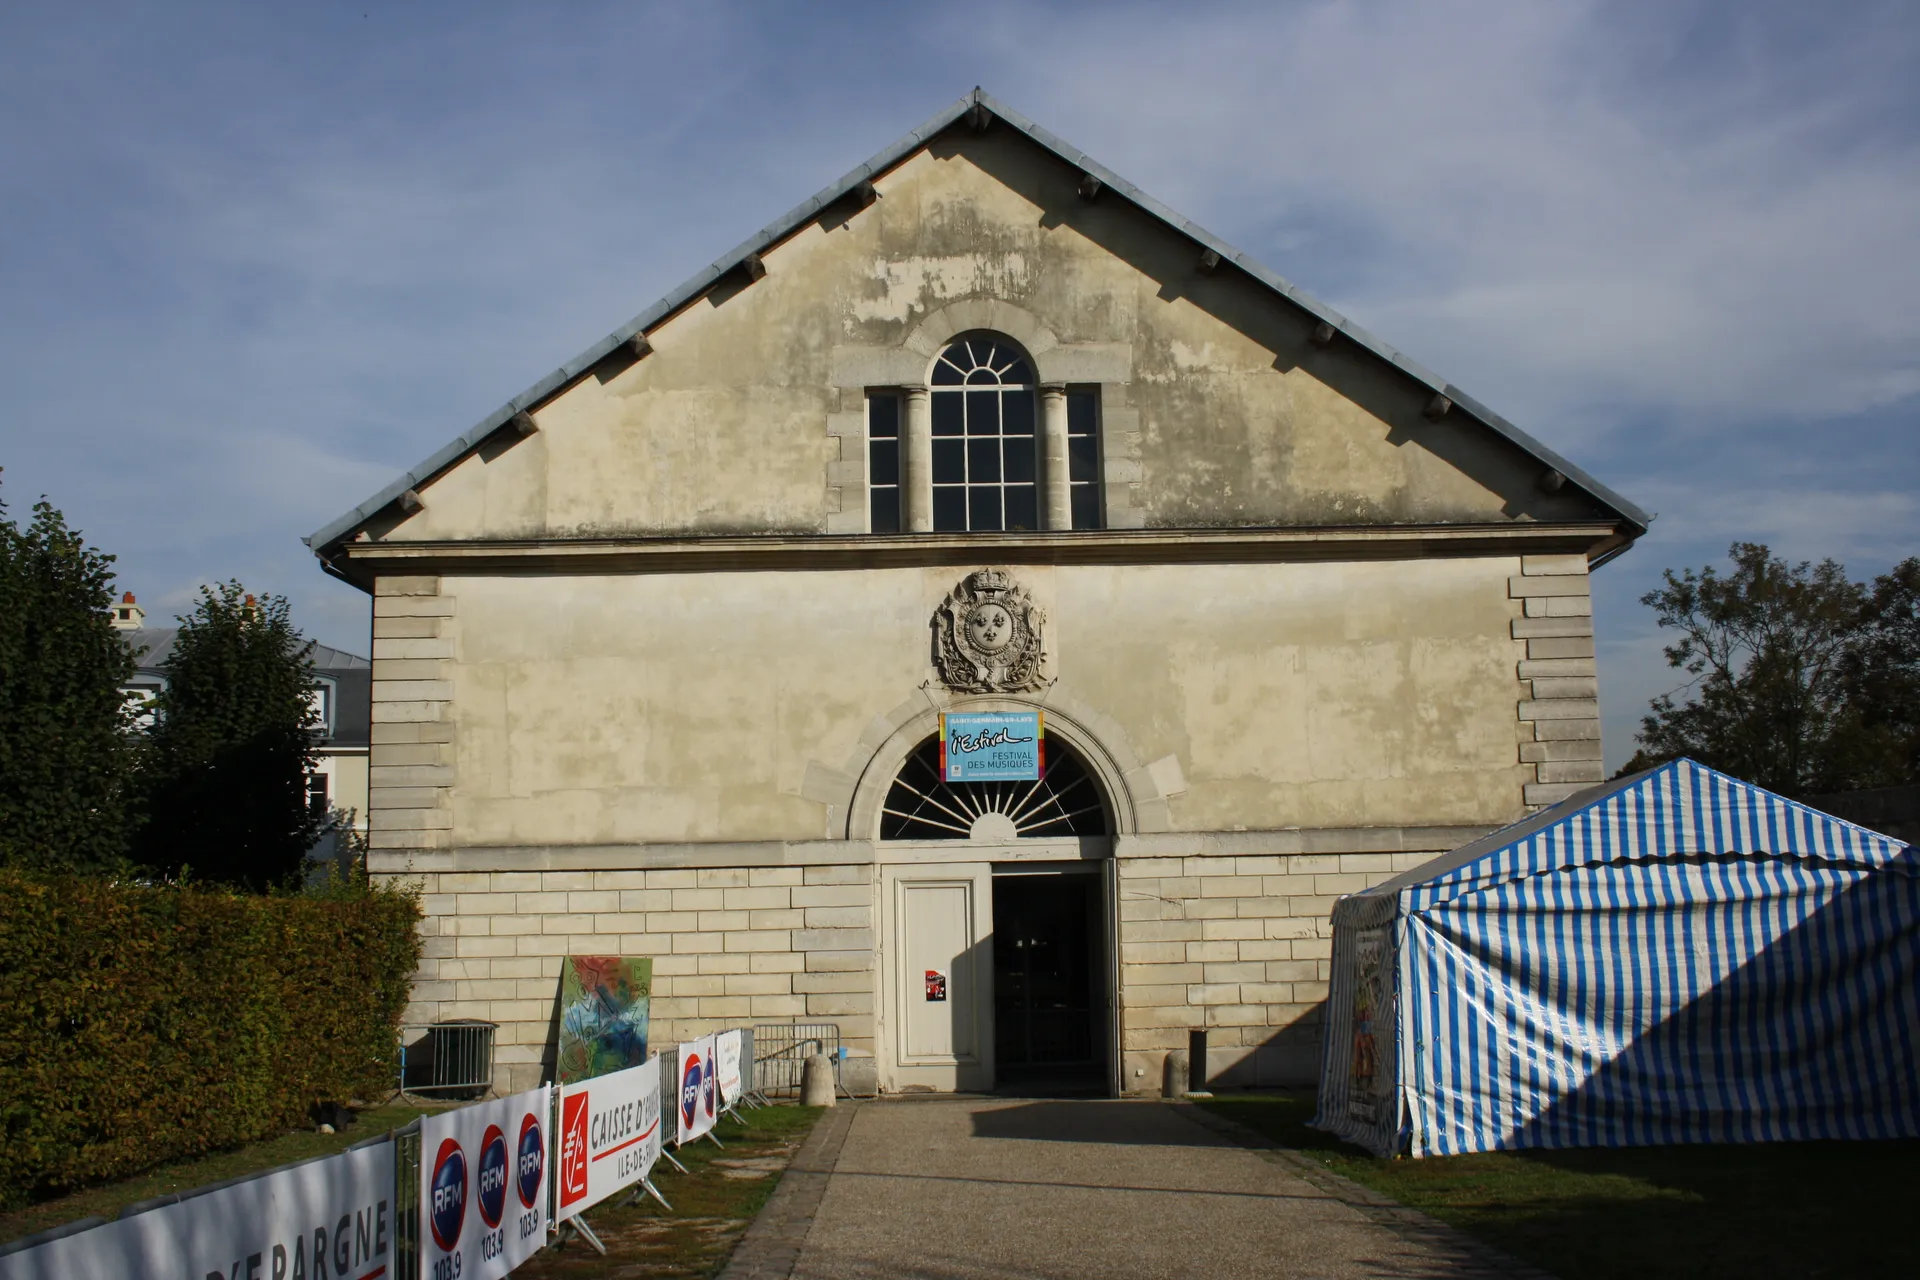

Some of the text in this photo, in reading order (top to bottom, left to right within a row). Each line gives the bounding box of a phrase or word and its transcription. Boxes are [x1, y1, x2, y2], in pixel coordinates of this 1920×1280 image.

[967, 759, 1034, 769] DES MUSIQUES
[992, 751, 1033, 760] FESTIVAL
[591, 1102, 633, 1150] CAISSE
[519, 1149, 541, 1178] RFM
[617, 1134, 656, 1179] ILE-DE-F
[481, 1164, 504, 1195] RFM
[434, 1180, 462, 1214] RFM
[206, 1199, 388, 1280] 'PARGNE
[519, 1208, 539, 1240] 103.9
[481, 1229, 504, 1262] 103.9
[434, 1250, 462, 1280] 103.9
